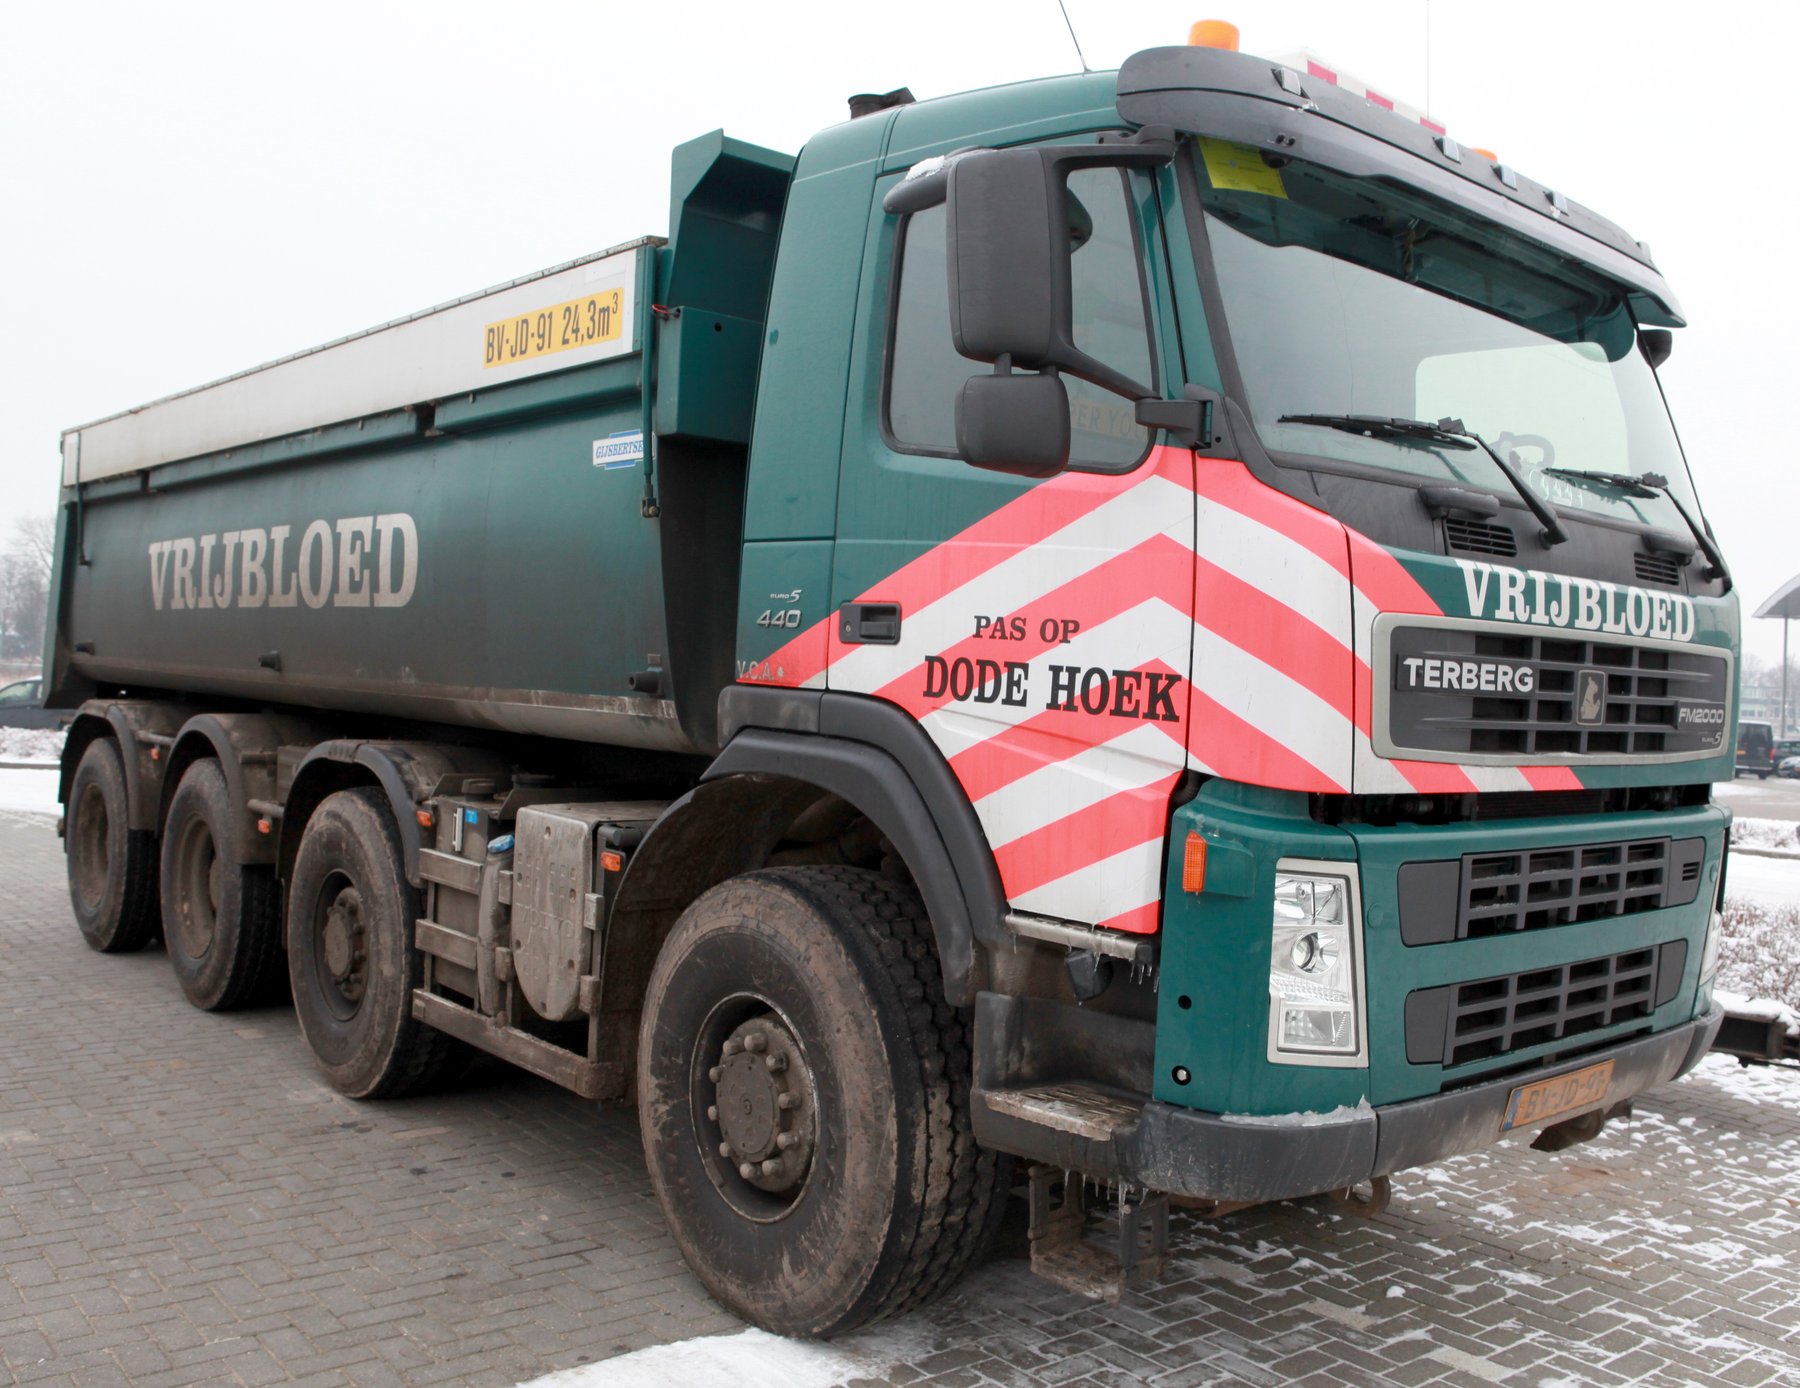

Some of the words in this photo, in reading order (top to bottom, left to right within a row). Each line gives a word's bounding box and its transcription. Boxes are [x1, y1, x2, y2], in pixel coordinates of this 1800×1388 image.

[149, 512, 419, 611] VRIJBLOED
[1454, 558, 1695, 642] VRIJBLOED
[756, 609, 801, 628] 440
[973, 615, 1027, 641] PAS
[1039, 618, 1080, 644] OP
[923, 655, 1030, 707] DODE
[1046, 664, 1182, 723] HOEK
[1403, 657, 1535, 692] TERBERG
[1678, 707, 1724, 724] FM2000
